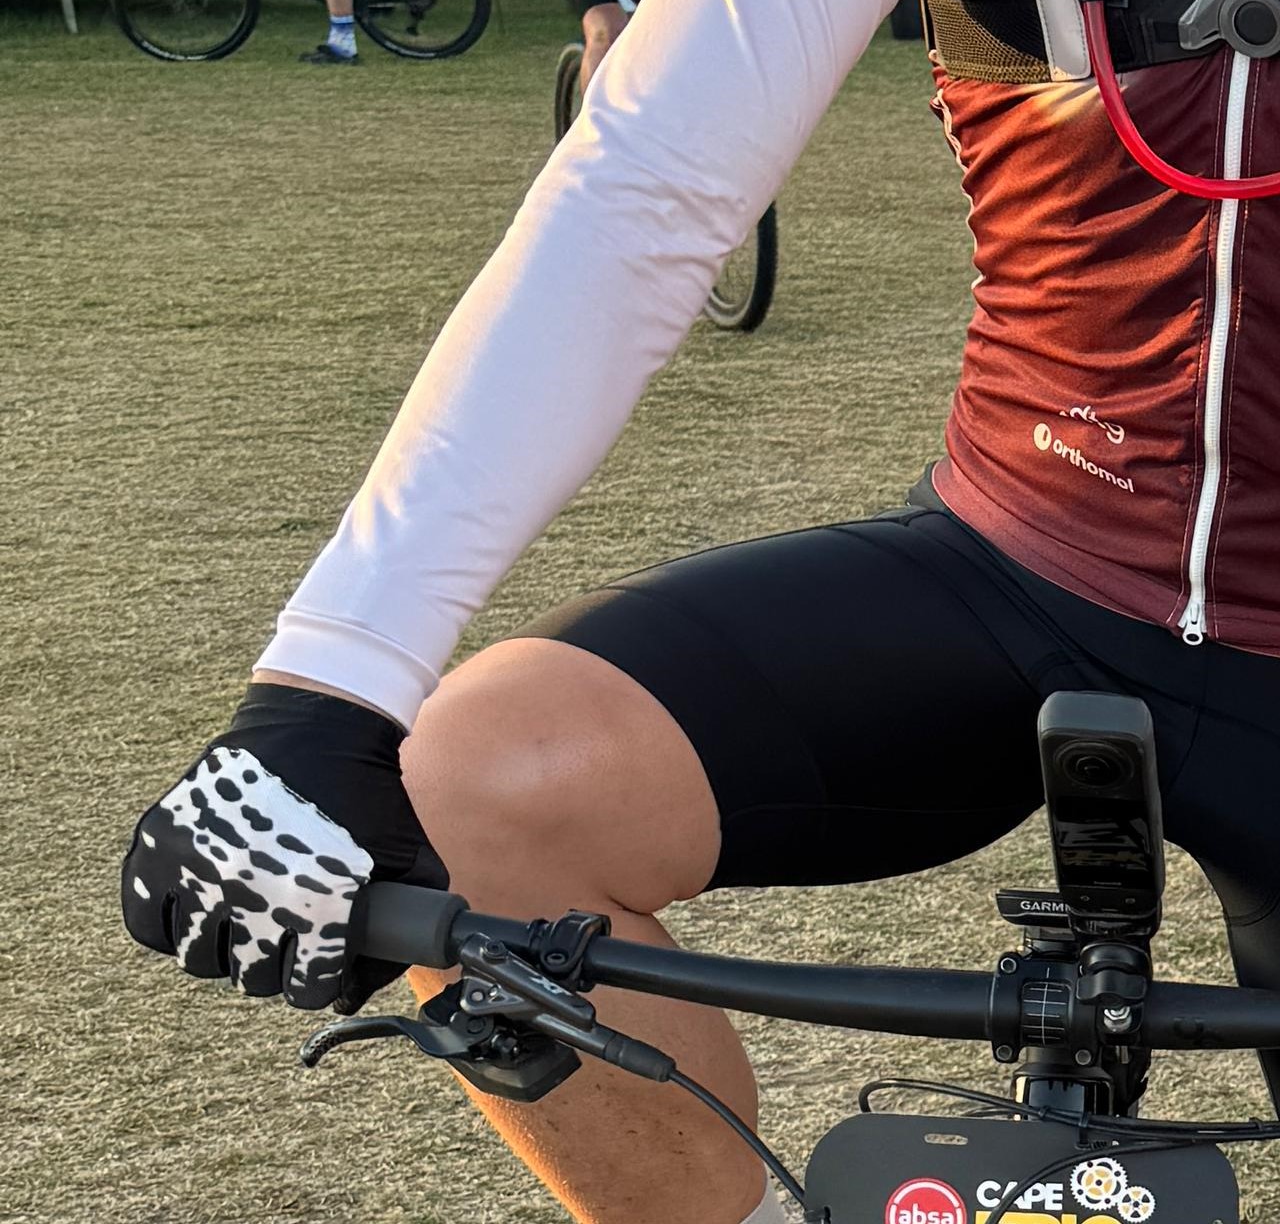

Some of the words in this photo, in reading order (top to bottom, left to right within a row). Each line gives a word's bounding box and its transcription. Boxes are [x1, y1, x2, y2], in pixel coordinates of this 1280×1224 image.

[1052, 439, 1134, 493] orthomol
[976, 1180, 1064, 1211] CAPE
[898, 1203, 951, 1224] absa
